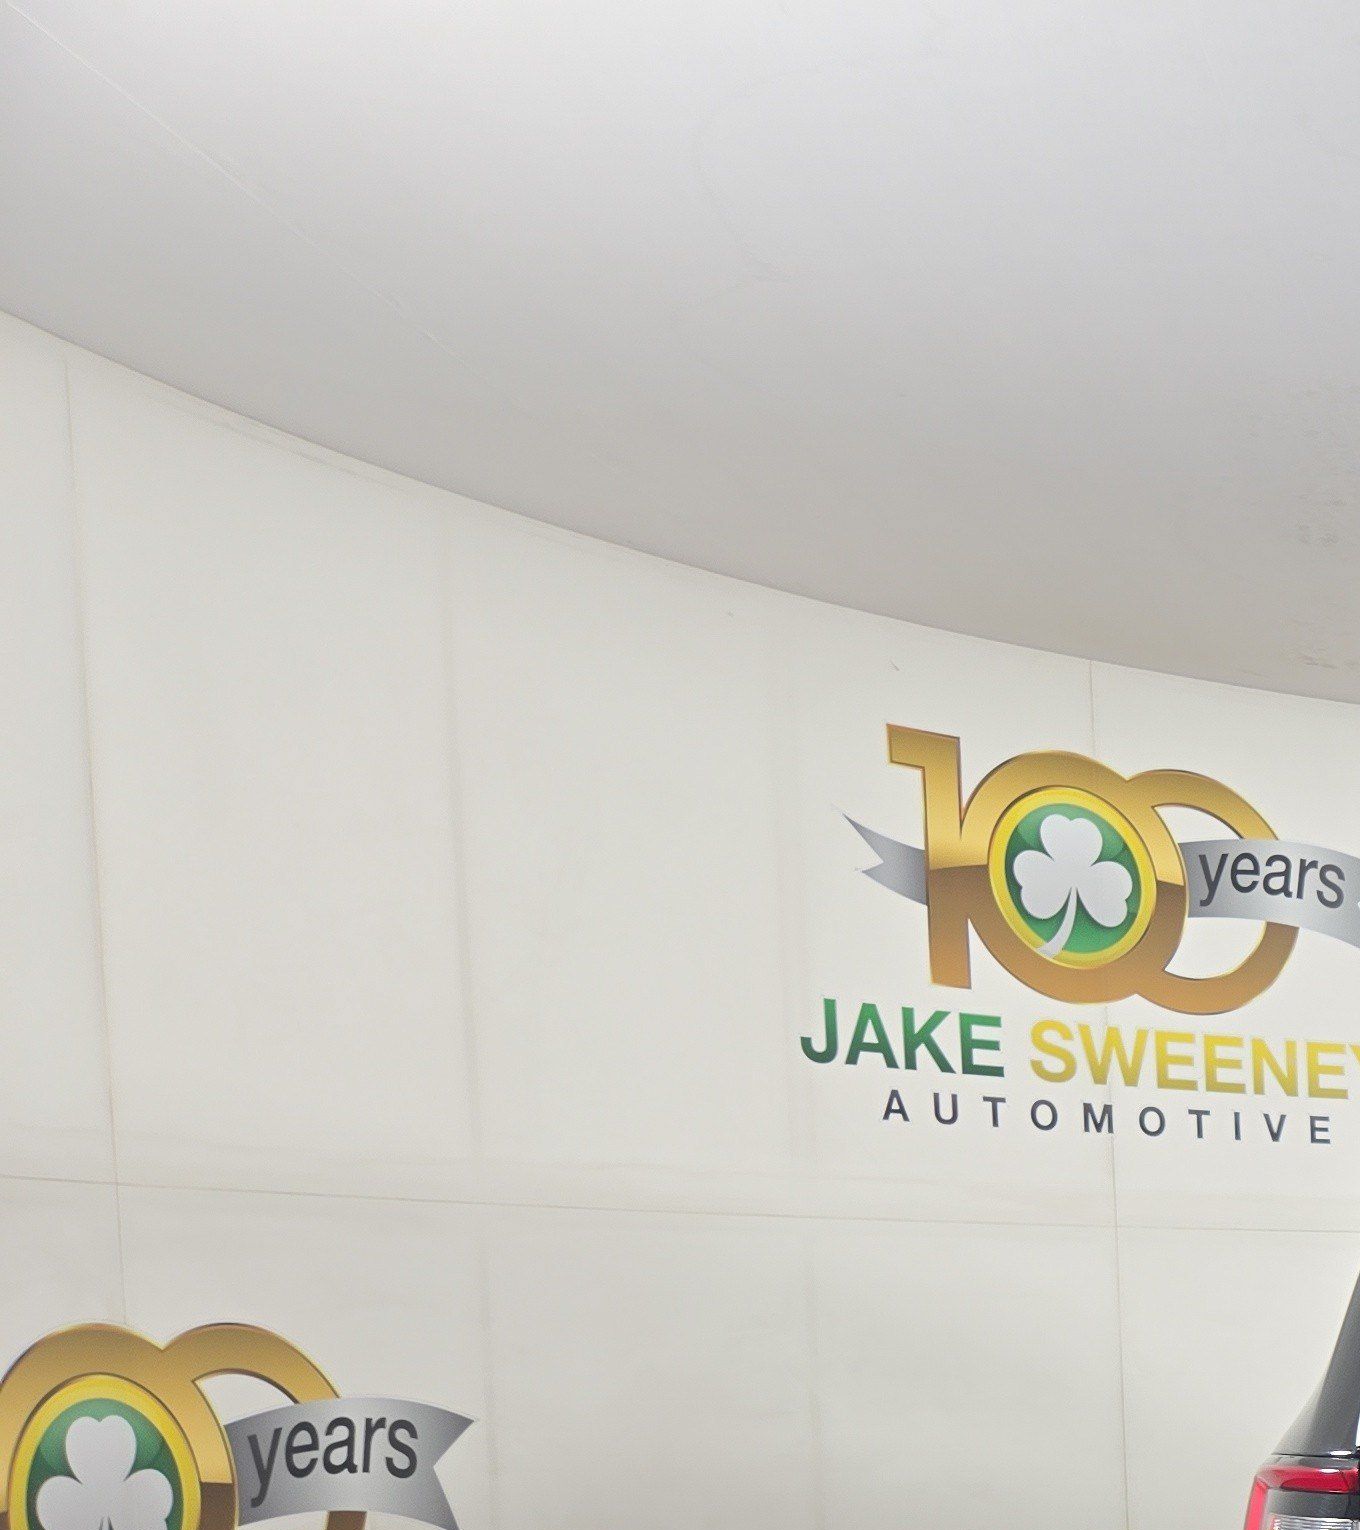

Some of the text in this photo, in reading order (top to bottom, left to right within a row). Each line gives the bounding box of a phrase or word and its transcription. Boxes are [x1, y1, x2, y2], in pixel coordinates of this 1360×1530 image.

[886, 722, 1301, 1015] 100
[1199, 851, 1345, 909] years
[800, 998, 1006, 1078] JAKE
[882, 1089, 1332, 1144] AUTOMOTIVE
[247, 1416, 418, 1507] years
